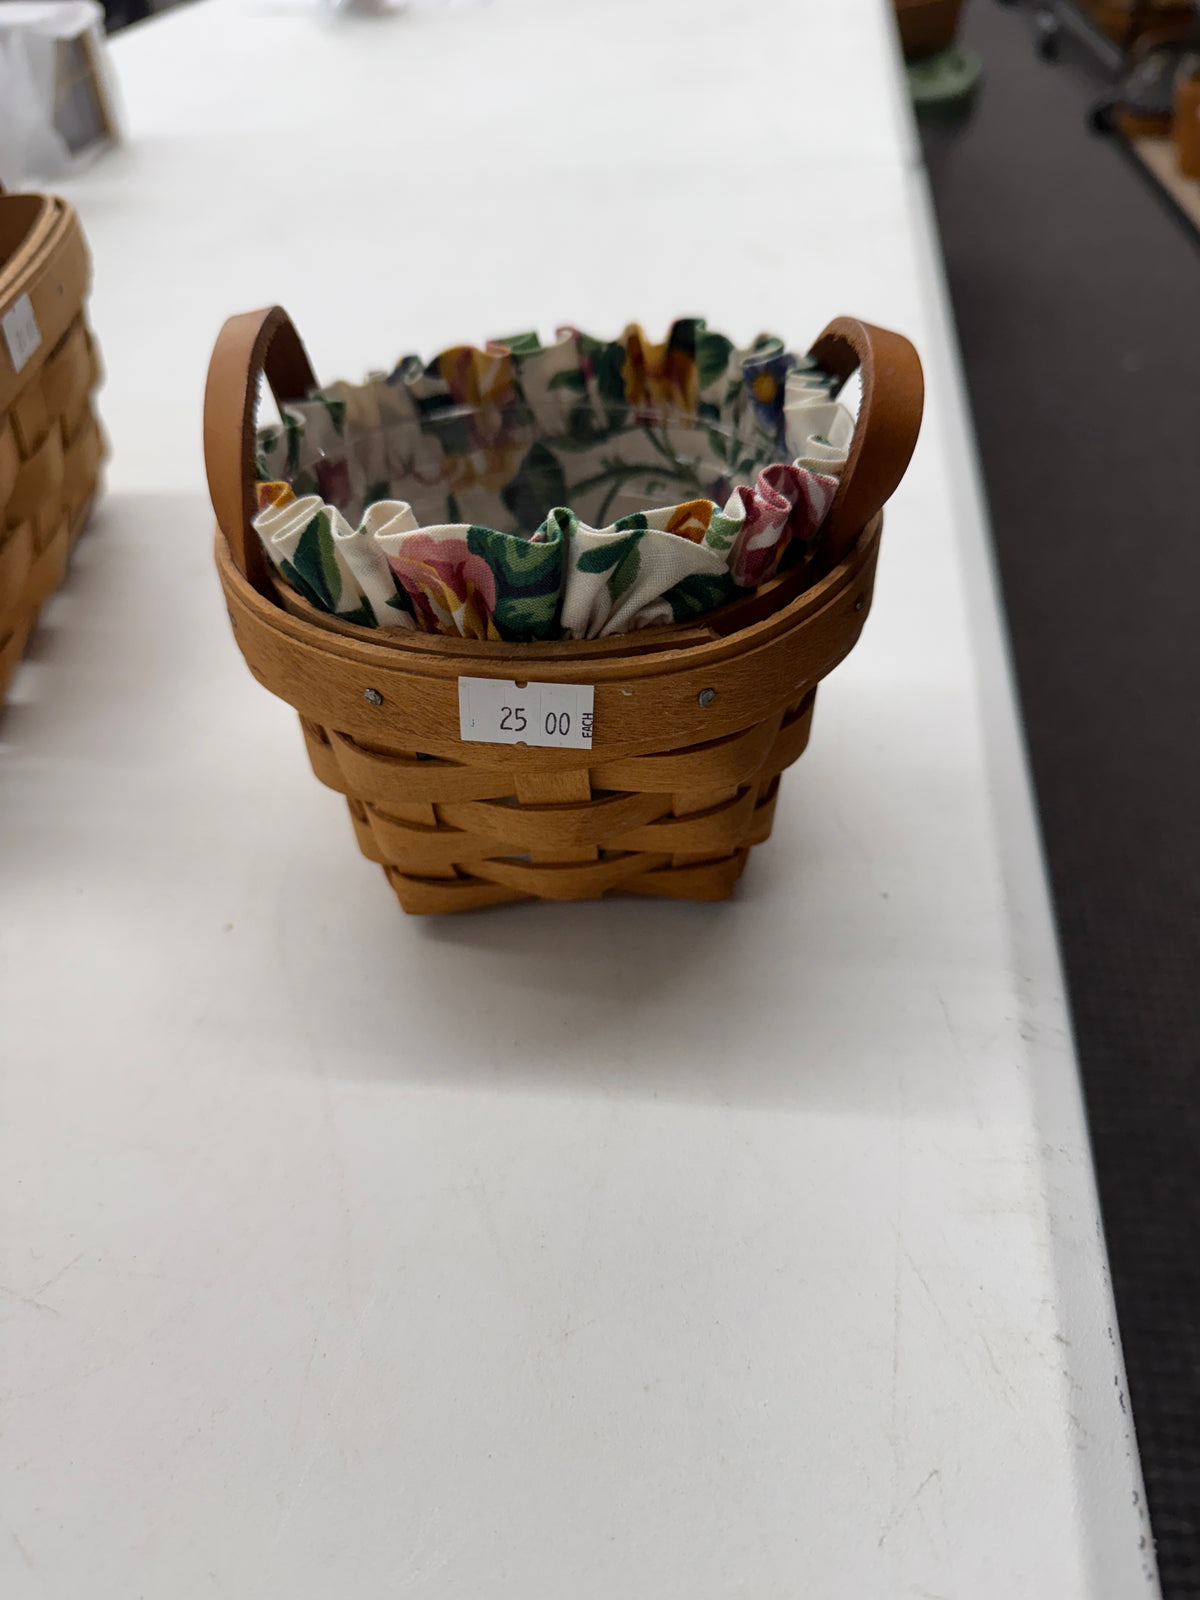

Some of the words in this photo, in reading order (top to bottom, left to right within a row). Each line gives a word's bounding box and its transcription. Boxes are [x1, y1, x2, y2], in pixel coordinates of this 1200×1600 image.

[500, 706, 527, 732] 25
[545, 712, 571, 736] 00
[582, 712, 593, 739] EACH
